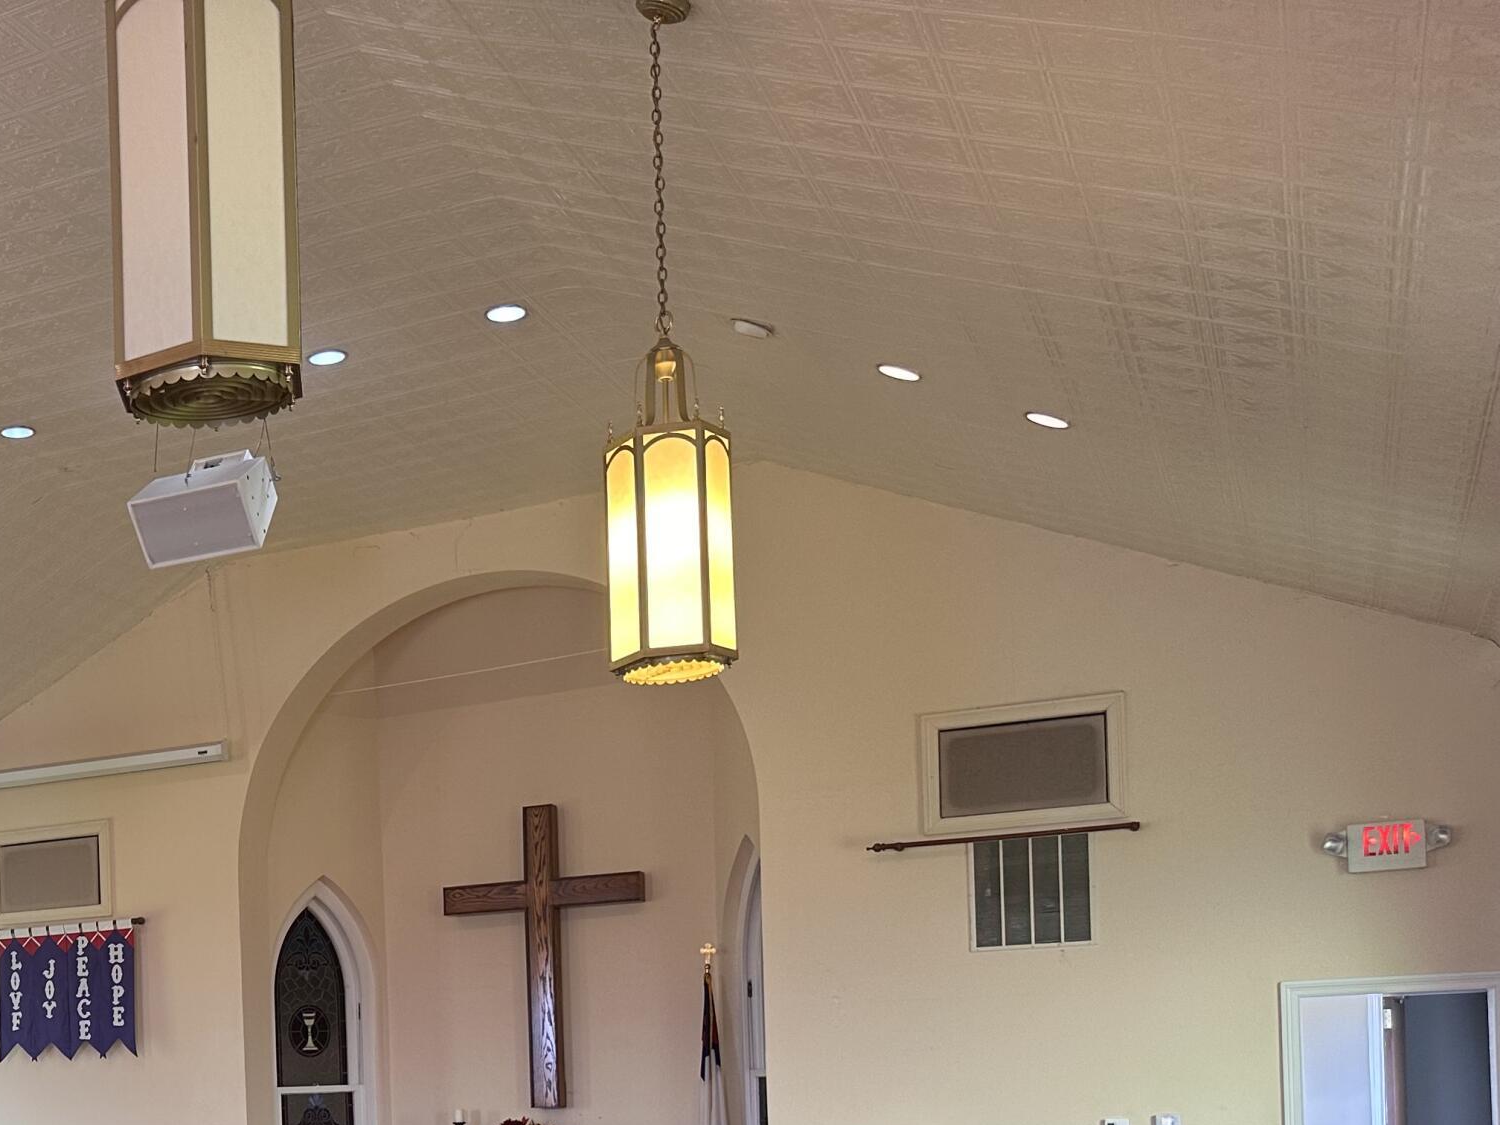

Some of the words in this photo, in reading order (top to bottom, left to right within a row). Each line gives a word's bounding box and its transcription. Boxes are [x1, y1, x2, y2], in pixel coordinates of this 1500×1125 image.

[1362, 823, 1412, 857] EXIT
[8, 951, 22, 1031] LOVE
[42, 959, 57, 1019] JOY
[75, 935, 92, 1041] PEACE
[107, 943, 125, 1027] HOPE
